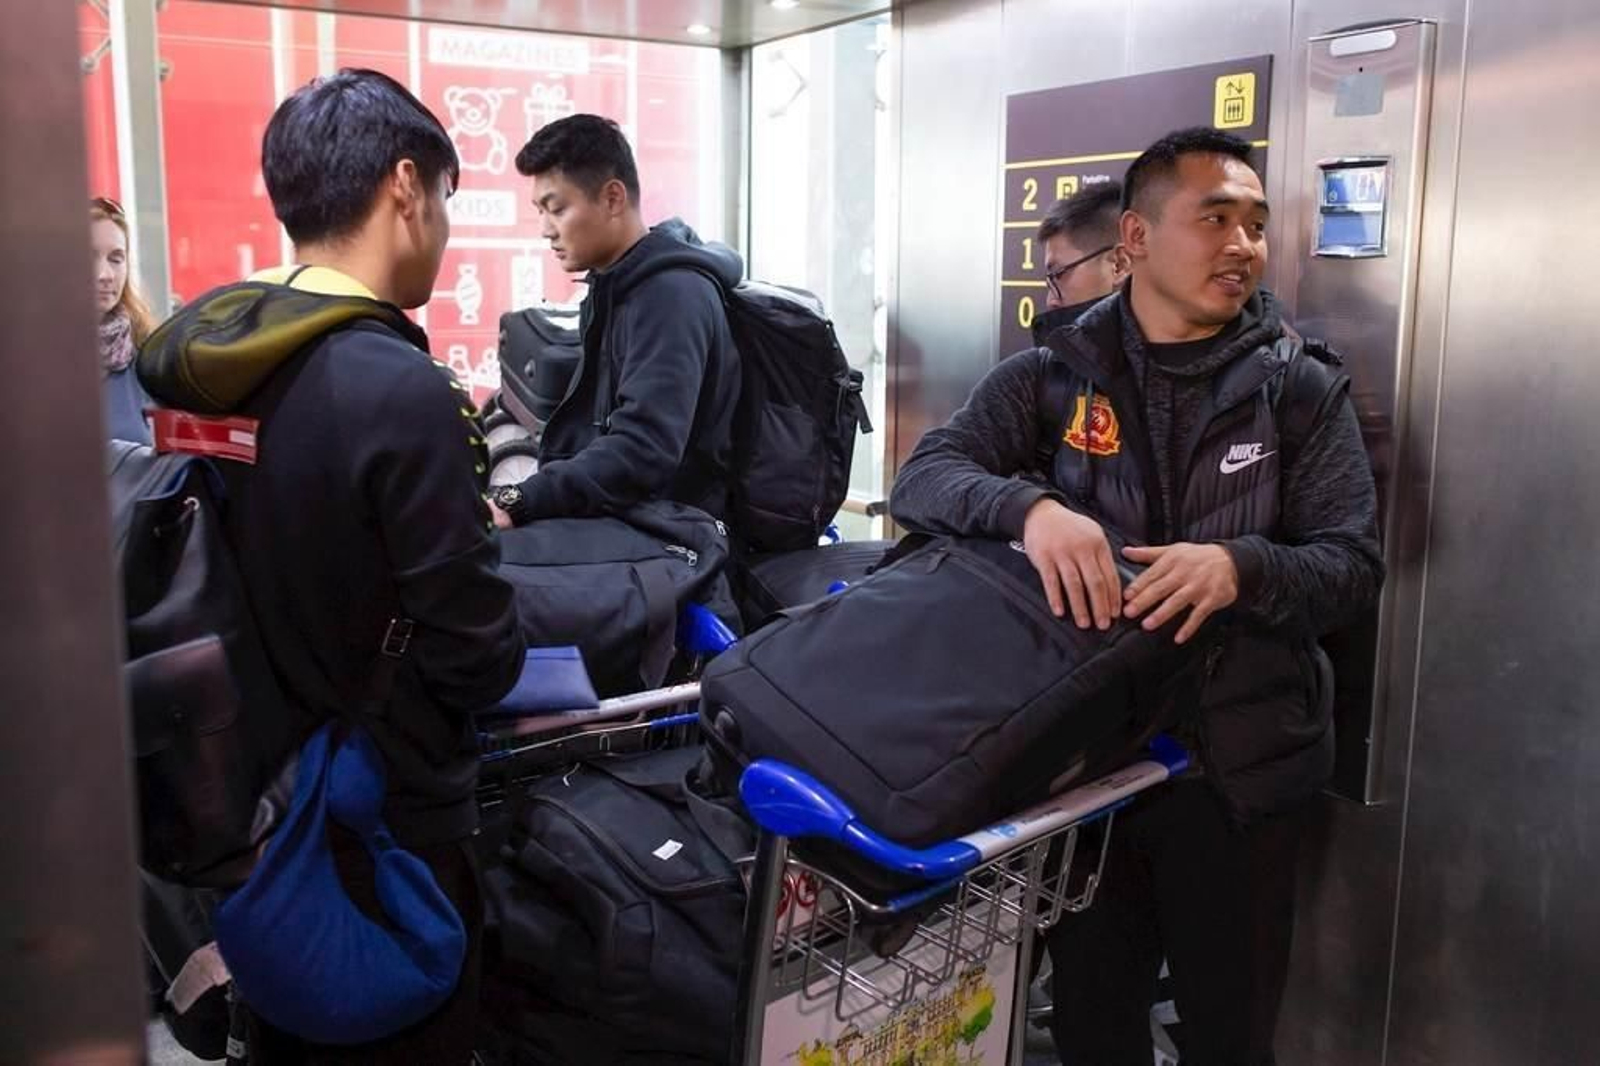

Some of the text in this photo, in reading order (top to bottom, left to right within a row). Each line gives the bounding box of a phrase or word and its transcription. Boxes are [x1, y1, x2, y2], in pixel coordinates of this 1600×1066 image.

[440, 37, 575, 67] MAGAZINES
[452, 197, 504, 215] KIDS
[1022, 177, 1038, 211] 2
[1021, 238, 1034, 270] 1
[1018, 295, 1035, 328] 0
[1227, 443, 1263, 461] NIKE
